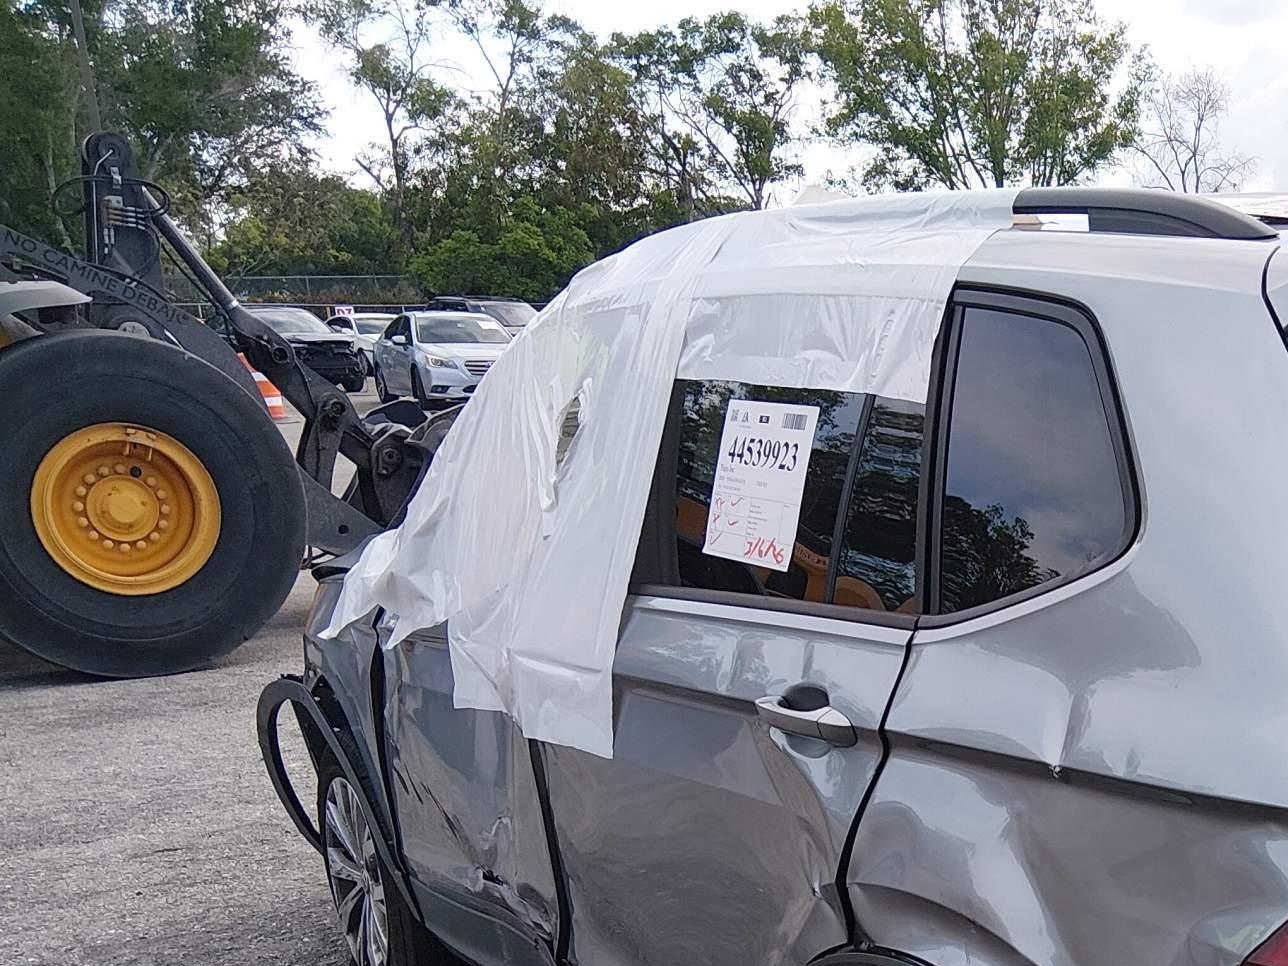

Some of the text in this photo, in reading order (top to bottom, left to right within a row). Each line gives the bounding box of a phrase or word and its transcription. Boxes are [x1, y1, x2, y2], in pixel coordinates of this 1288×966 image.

[4, 230, 38, 253] NO
[43, 248, 120, 293] CAMINE
[728, 435, 799, 472] 44539923
